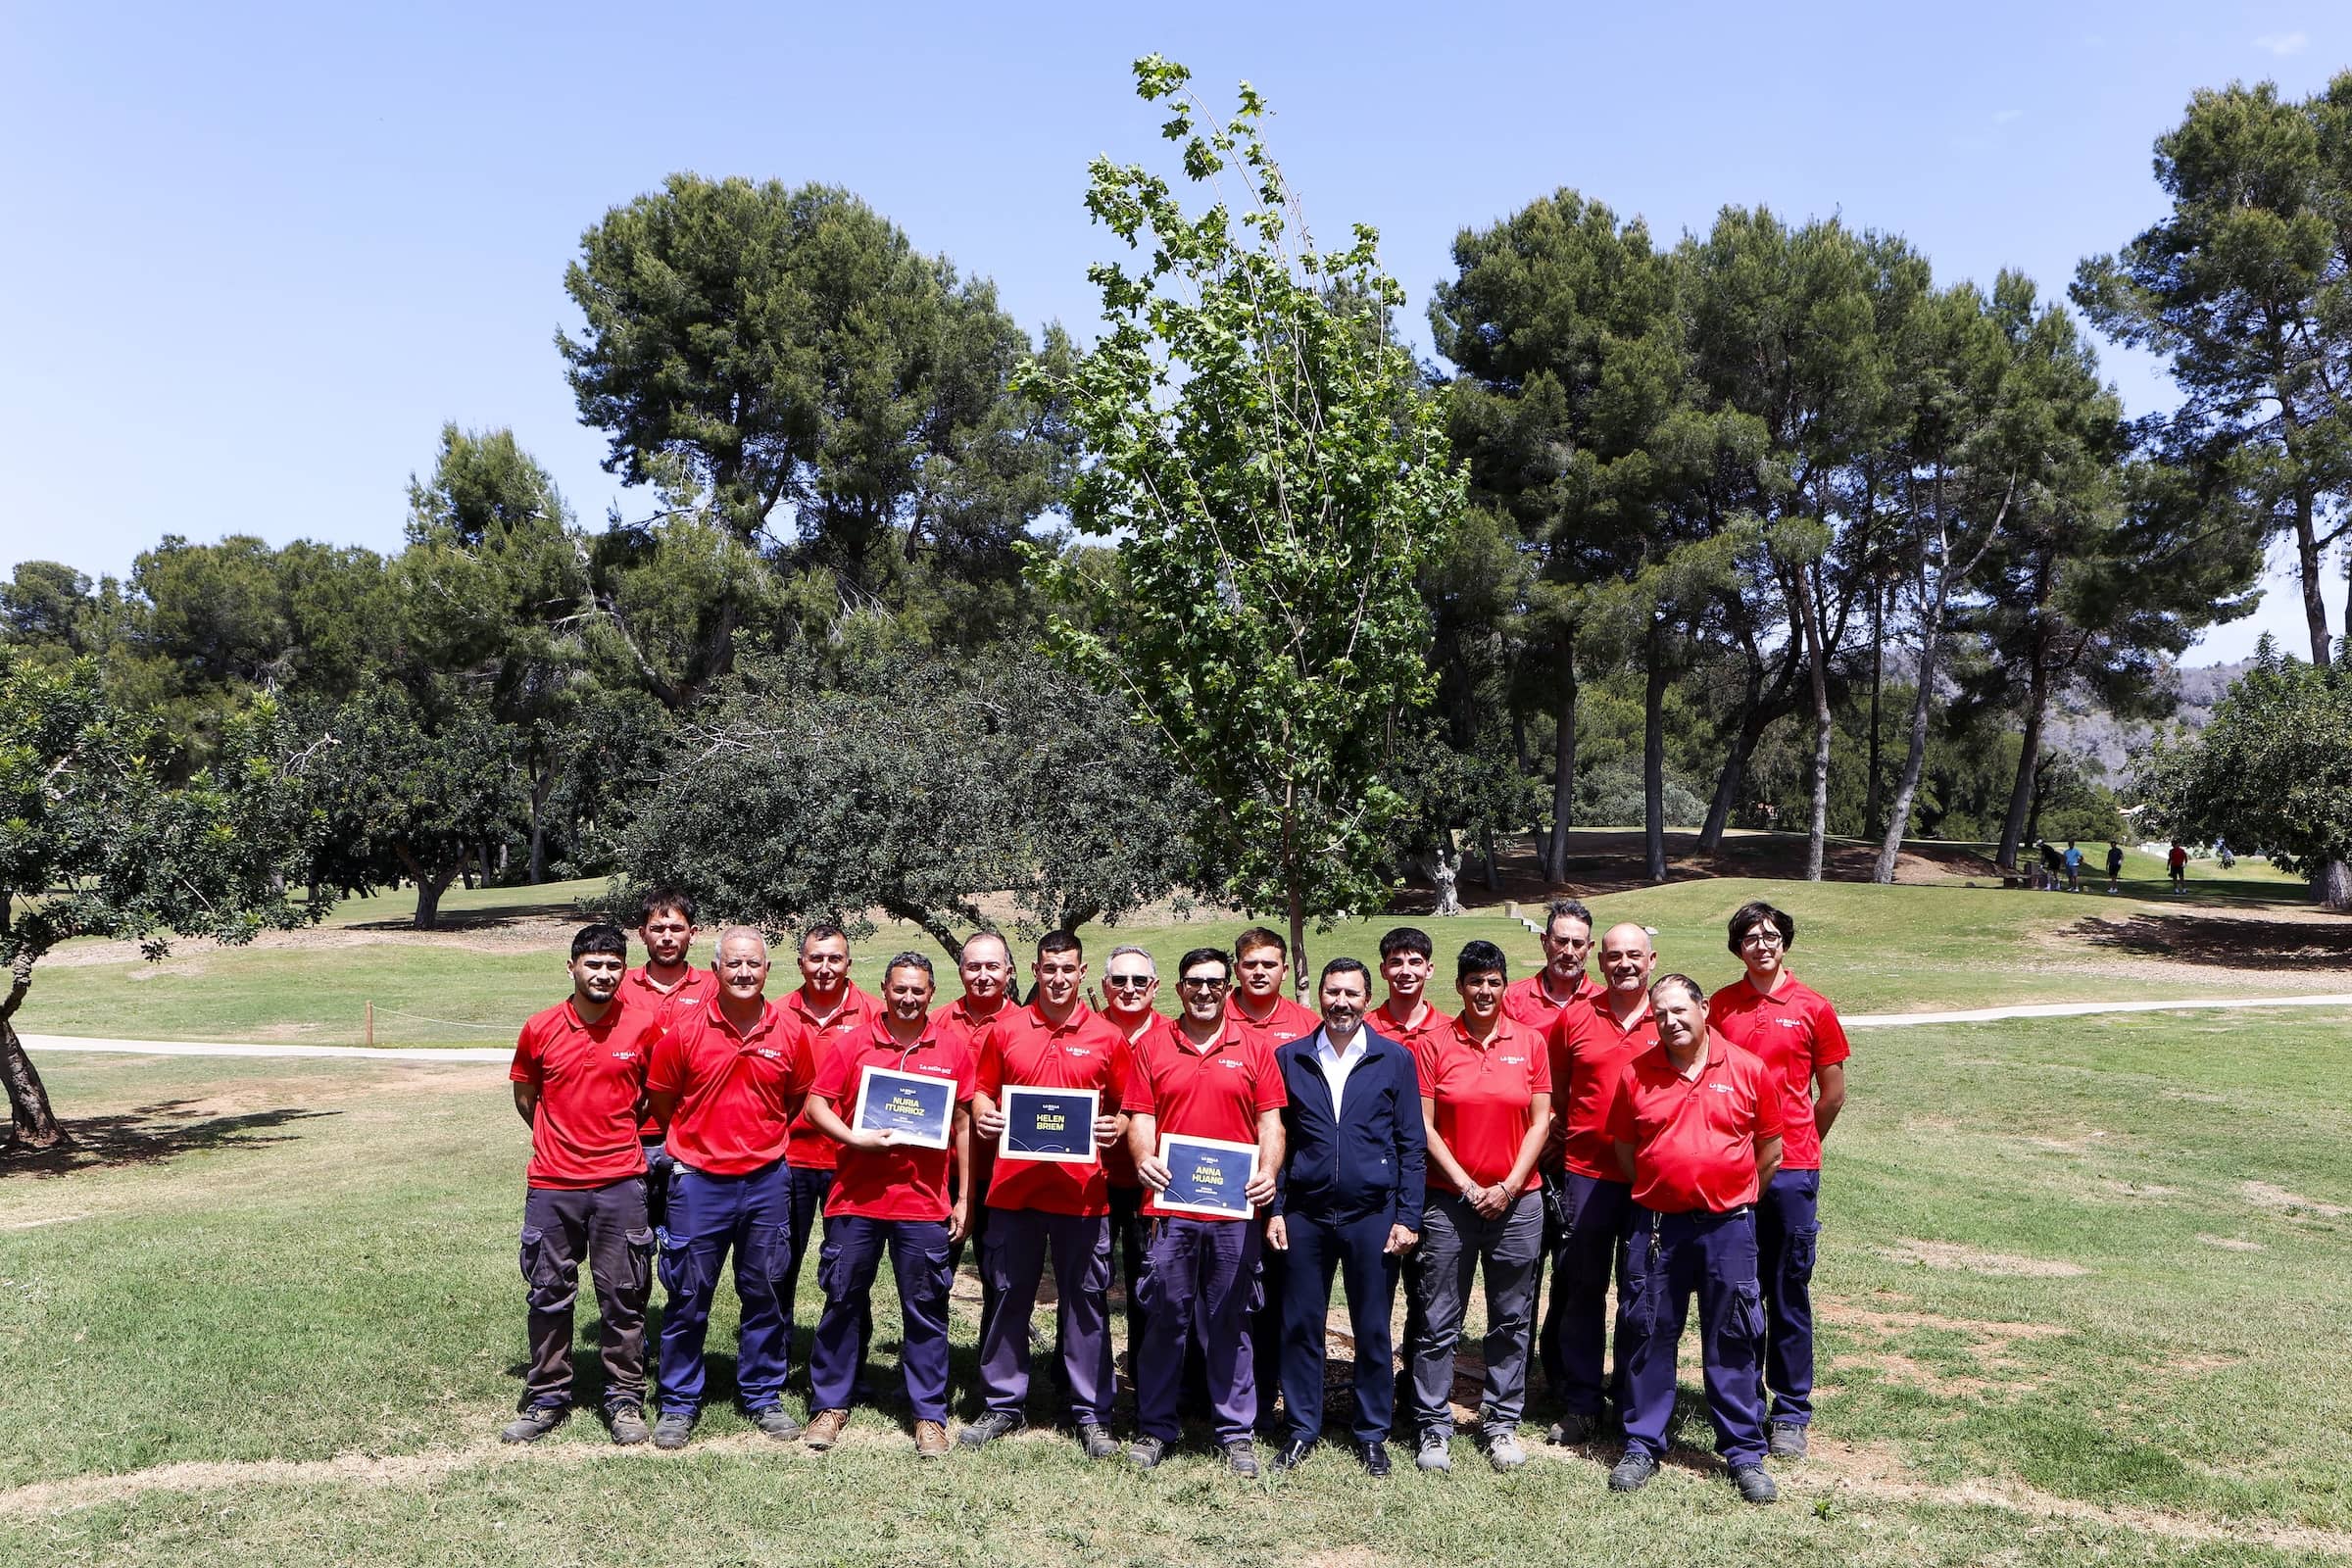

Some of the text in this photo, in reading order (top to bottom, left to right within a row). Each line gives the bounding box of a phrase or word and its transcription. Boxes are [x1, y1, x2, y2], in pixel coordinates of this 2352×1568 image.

[893, 1097, 920, 1107] NURIA
[885, 1103, 925, 1116] ITURRIOZ
[1036, 1114, 1065, 1122] HELEN
[1036, 1122, 1064, 1131] BRIEM
[1196, 1166, 1222, 1176] ANNA
[1192, 1174, 1224, 1185] HUANG
